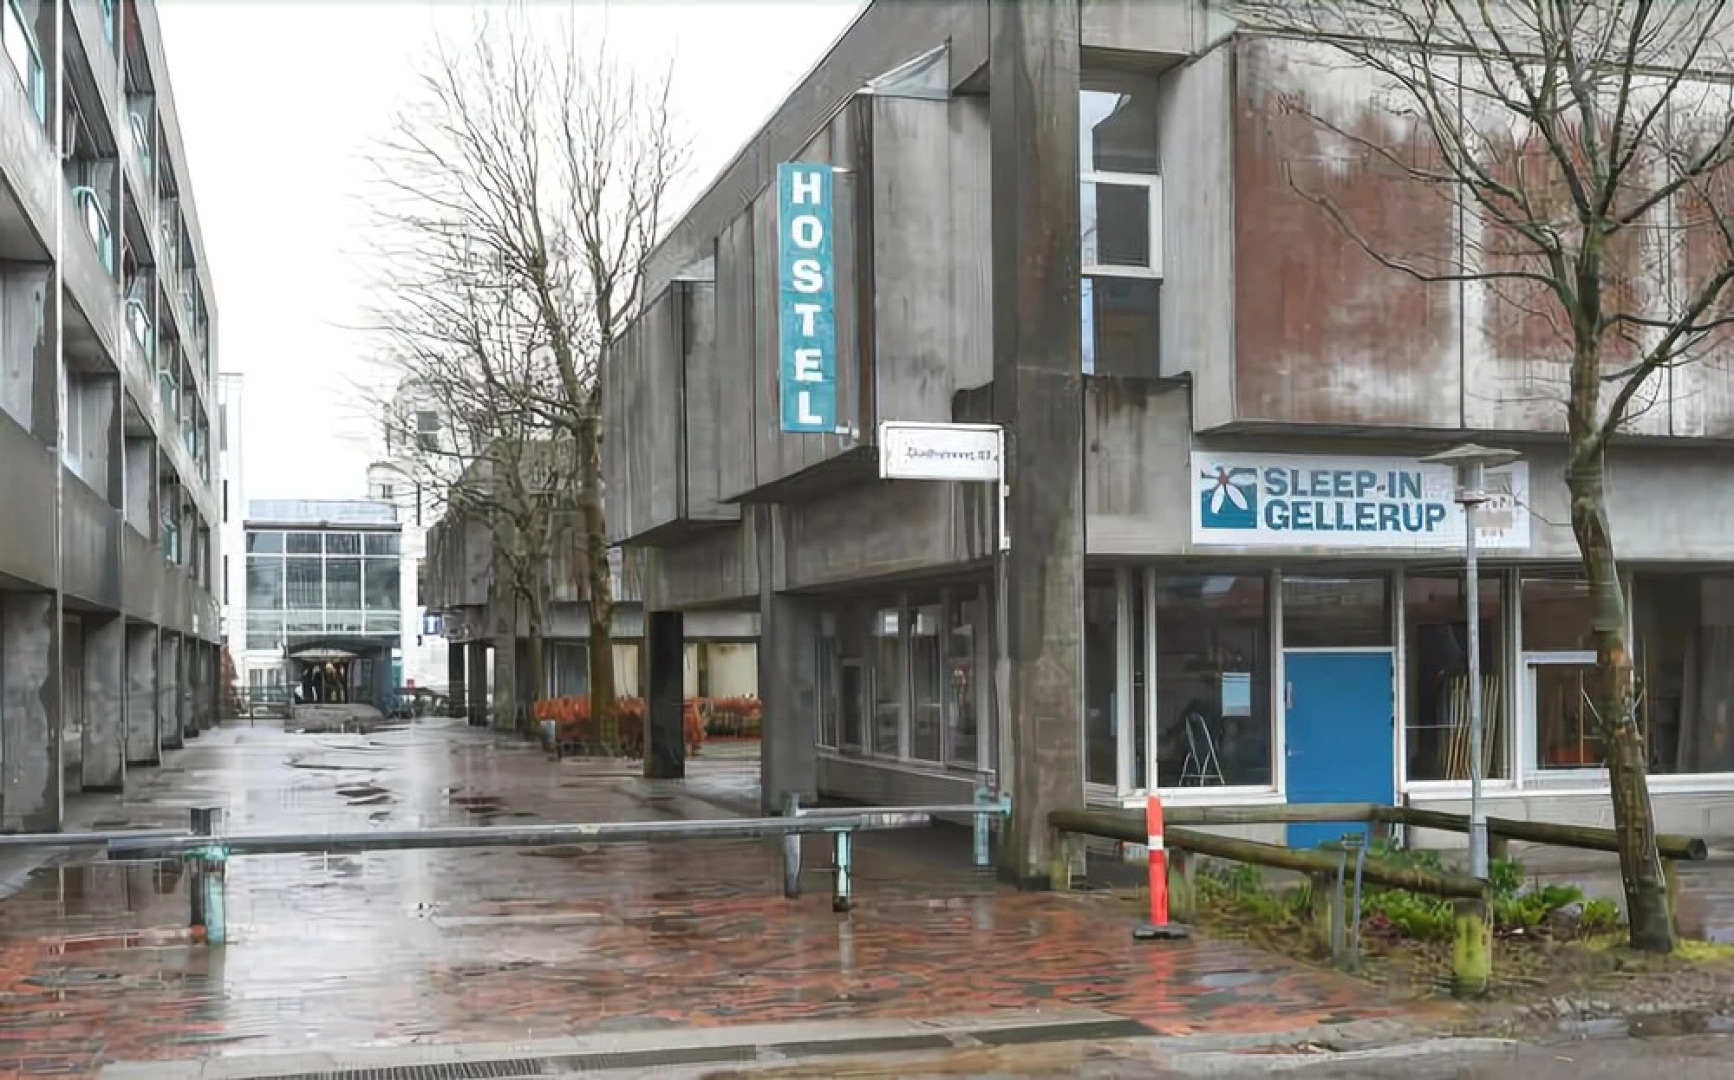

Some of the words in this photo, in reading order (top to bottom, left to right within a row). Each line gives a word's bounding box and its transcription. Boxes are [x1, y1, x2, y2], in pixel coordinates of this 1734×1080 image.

[791, 171, 823, 424] HOSTEL
[1264, 468, 1421, 498] SLEEP-IN
[1264, 500, 1446, 531] GELLERUP
